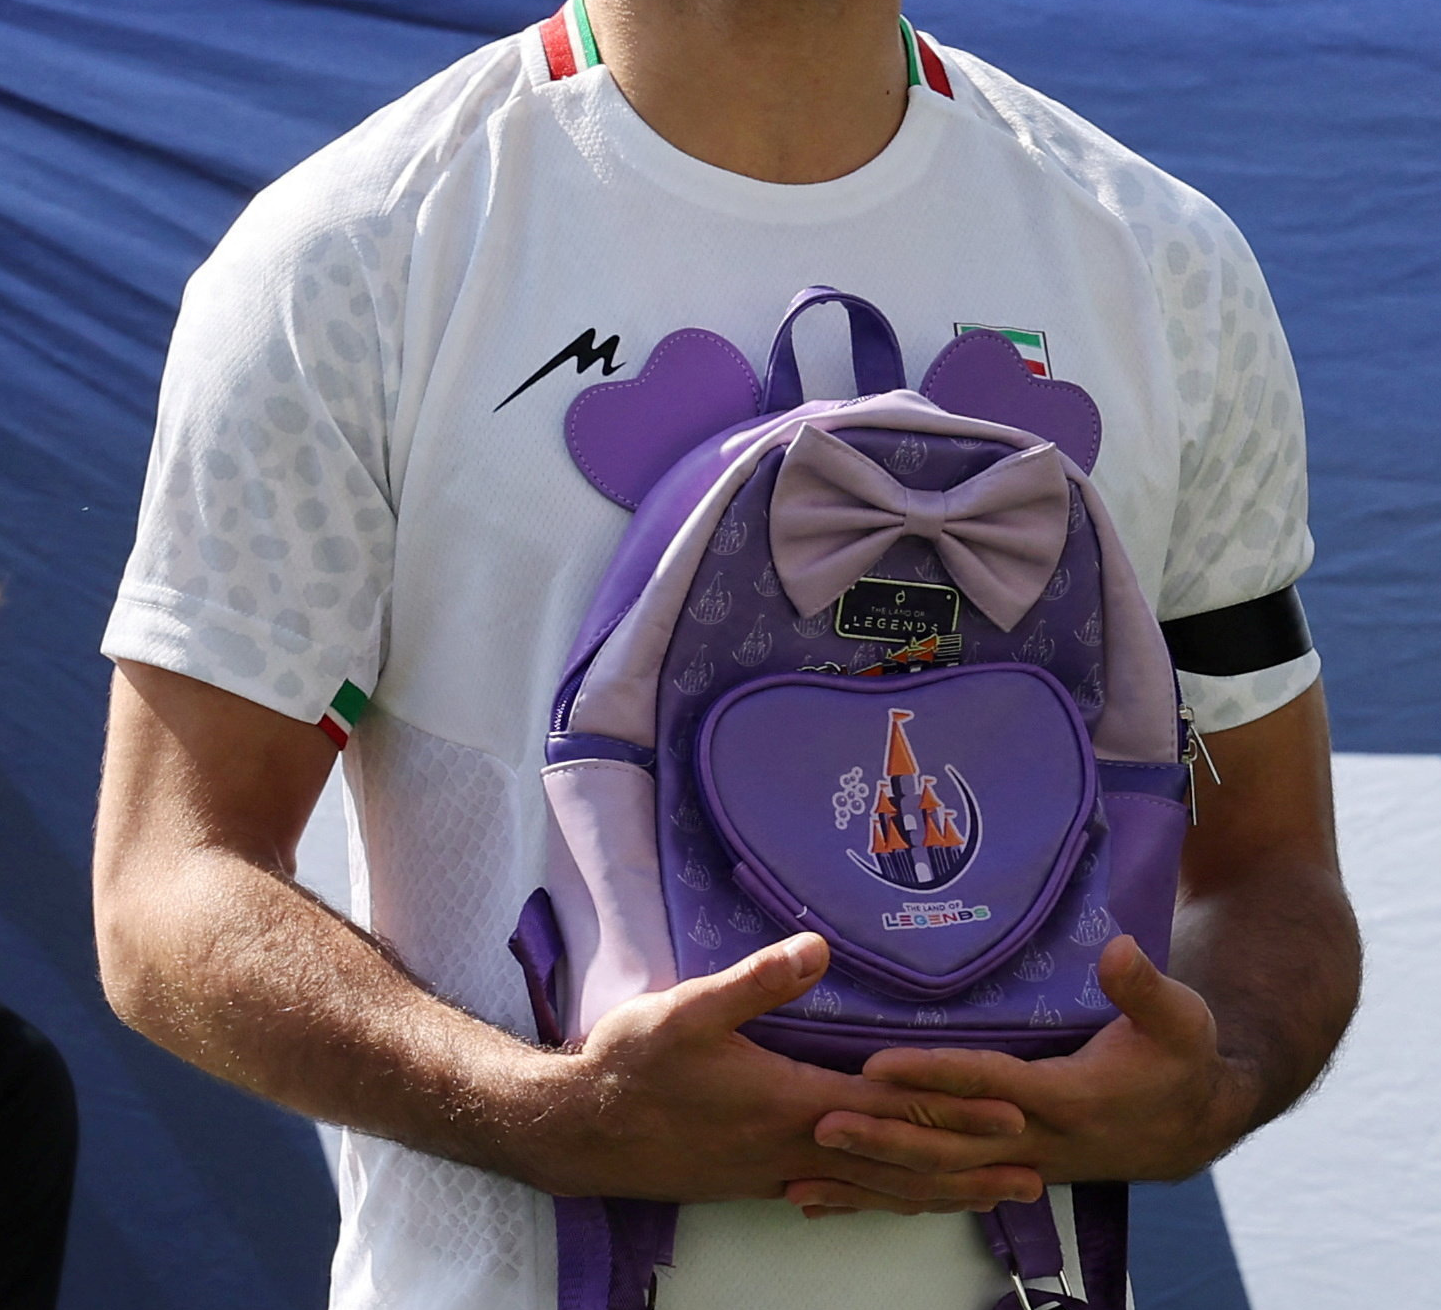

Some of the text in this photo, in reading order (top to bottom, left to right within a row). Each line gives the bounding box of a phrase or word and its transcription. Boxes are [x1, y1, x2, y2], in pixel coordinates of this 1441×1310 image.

[852, 615, 938, 633] LEGENDS
[905, 901, 961, 912] THE LAND OF
[884, 907, 989, 928] LEGENDS
